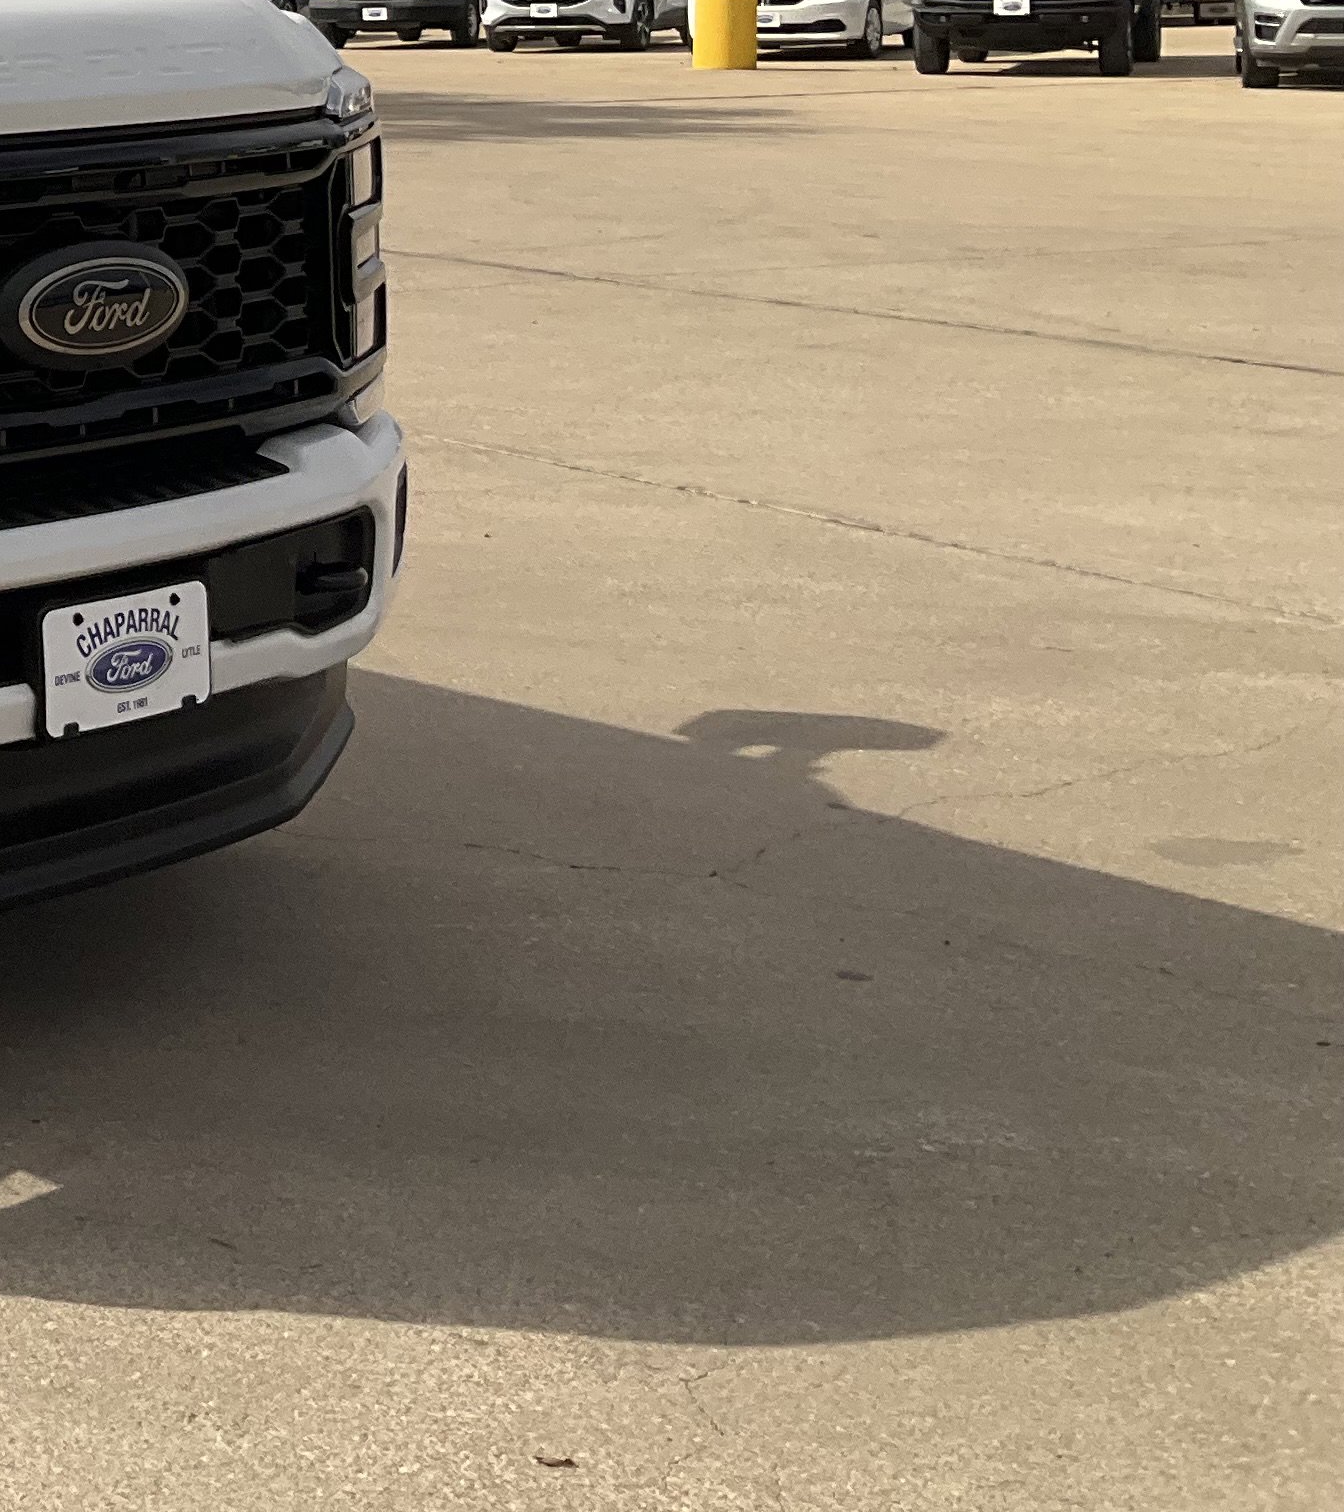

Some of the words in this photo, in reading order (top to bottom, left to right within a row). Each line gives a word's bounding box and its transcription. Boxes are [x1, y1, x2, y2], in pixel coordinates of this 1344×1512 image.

[64, 278, 151, 336] Ford
[76, 607, 180, 658] CHAPARRAL
[54, 671, 81, 686] DEVINE
[106, 649, 154, 683] Ford
